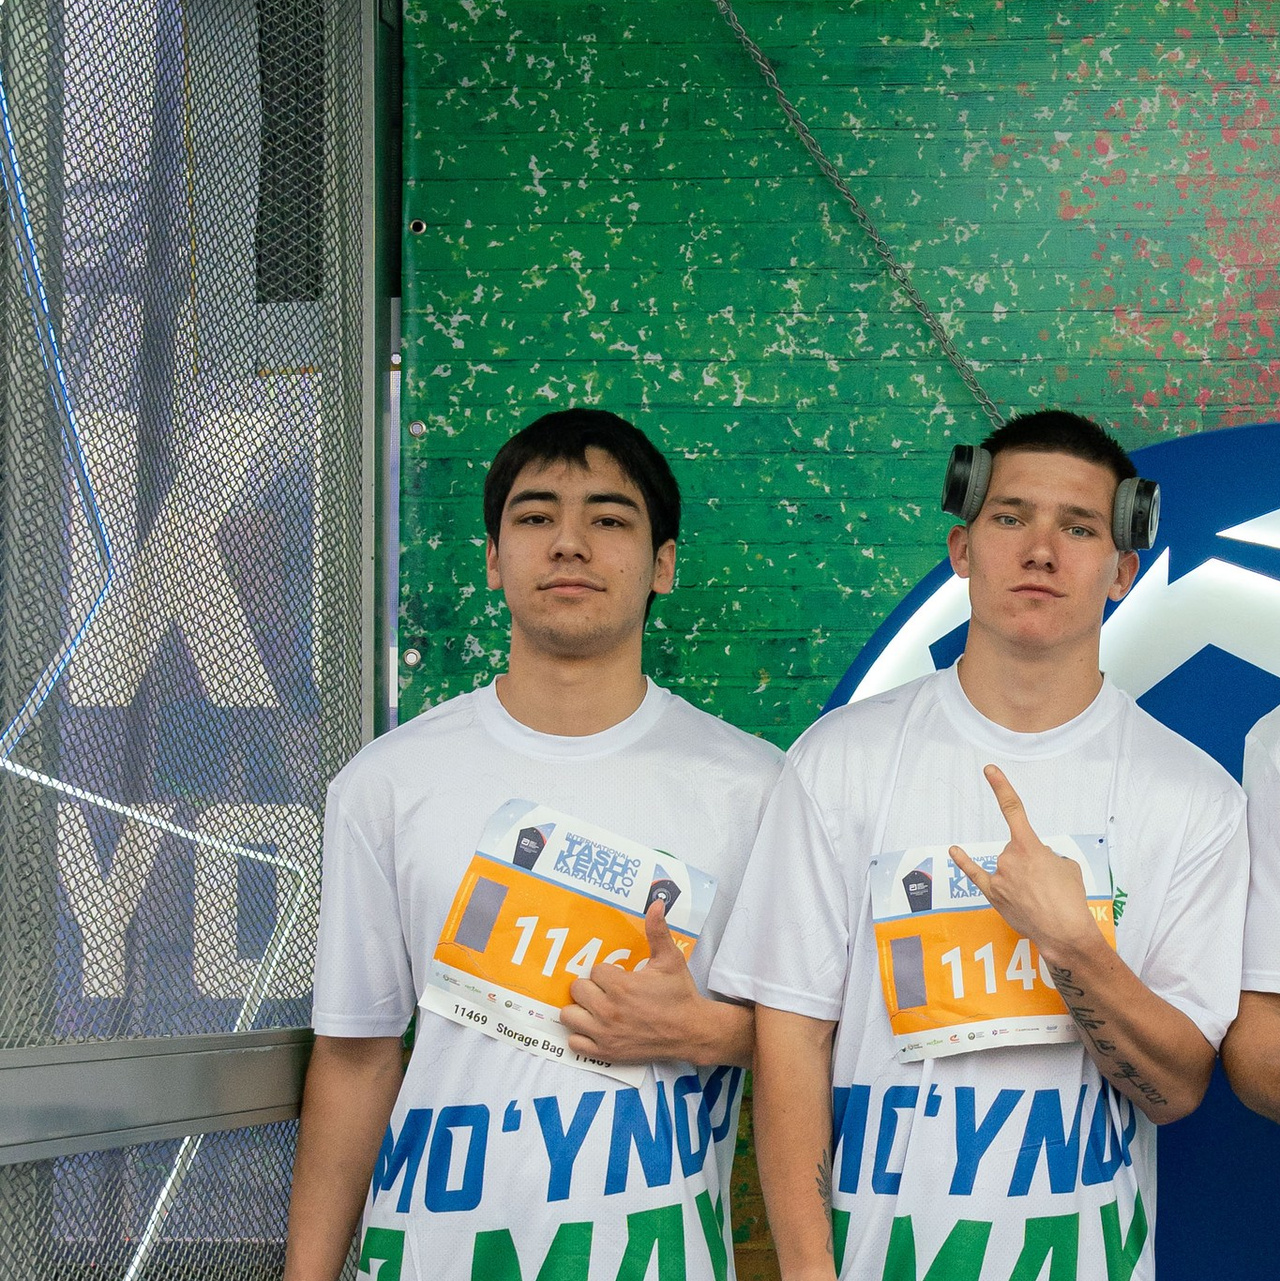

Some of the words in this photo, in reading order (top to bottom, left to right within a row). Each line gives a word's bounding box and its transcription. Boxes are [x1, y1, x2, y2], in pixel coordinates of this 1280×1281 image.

[564, 836, 630, 878] TASH
[566, 831, 630, 860] INTERNATIONAL
[553, 865, 624, 897] MARATHON
[555, 850, 624, 888] KENT
[616, 858, 641, 898] 2026
[453, 1004, 488, 1026] 11469
[496, 1022, 539, 1048] Storage
[541, 1039, 565, 1058] Bag
